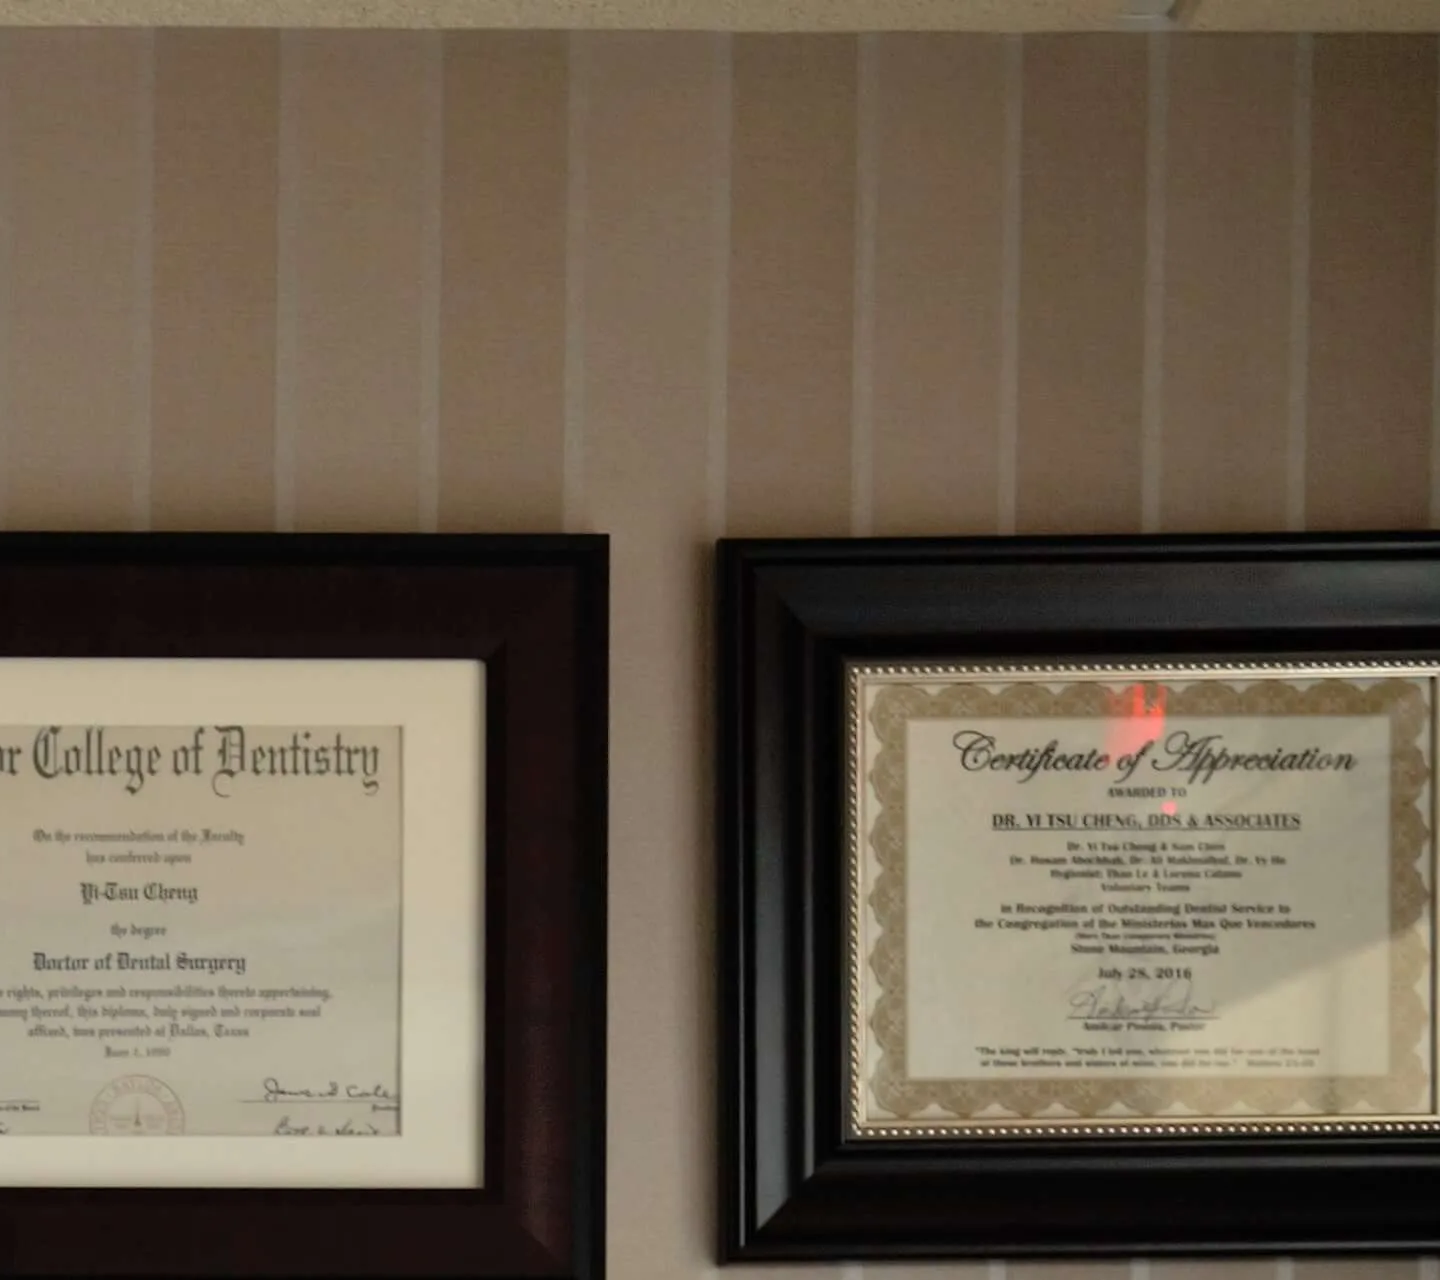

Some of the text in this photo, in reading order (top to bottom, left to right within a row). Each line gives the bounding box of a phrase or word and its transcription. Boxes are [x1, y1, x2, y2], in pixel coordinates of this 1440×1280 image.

[33, 725, 161, 794] College
[172, 727, 205, 777] of
[212, 726, 380, 797] Dentistry
[952, 730, 1357, 784] Certificate of Appreciation
[1171, 787, 1186, 798] TO
[992, 813, 1019, 828] DR.
[1046, 813, 1075, 828] TSU
[1148, 814, 1181, 828] DDS
[1187, 814, 1198, 828] &
[1203, 814, 1300, 828] ASSOCIATES
[143, 882, 199, 904] Cheng
[33, 952, 247, 975] Doctor of Dental Surgery
[1155, 967, 1192, 980] 2016
